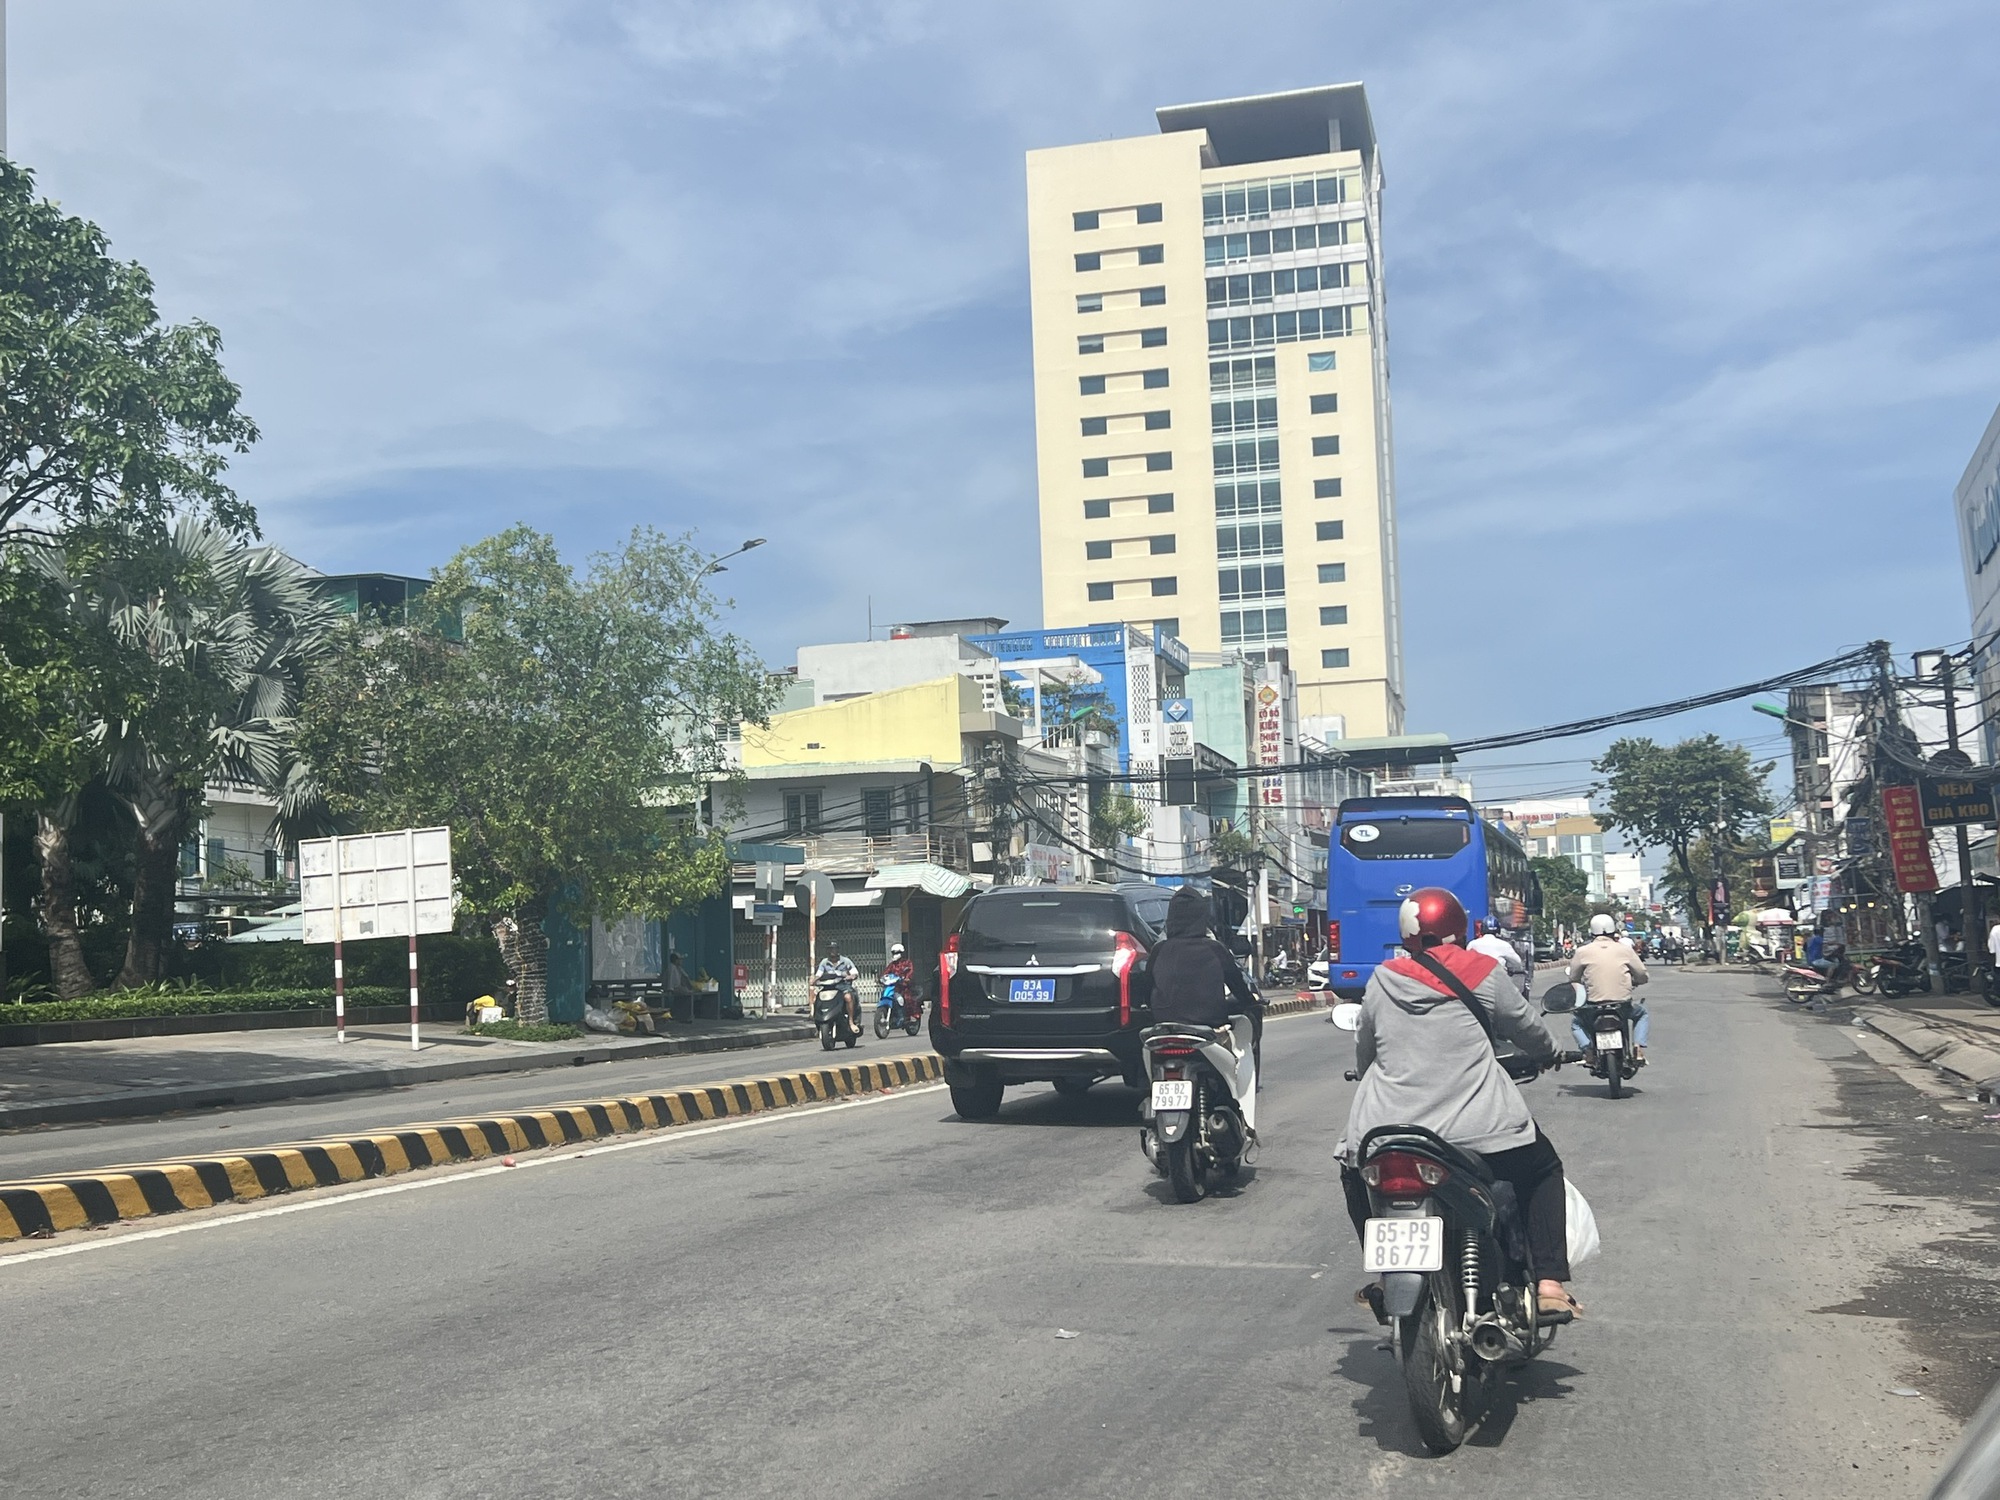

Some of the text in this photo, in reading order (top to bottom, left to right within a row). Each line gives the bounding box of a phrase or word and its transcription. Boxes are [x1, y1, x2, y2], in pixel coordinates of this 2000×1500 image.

[1166, 747, 1192, 757] TOURS
[1262, 788, 1283, 805] 15
[1938, 783, 1974, 799] NỆM
[1929, 803, 1954, 820] GIÁ
[1959, 804, 1988, 817] KHO
[1023, 980, 1042, 990] 83A
[1014, 991, 1049, 1001] 005.99
[1159, 1083, 1185, 1095] 65-B2
[1155, 1095, 1189, 1107] 799.77
[1376, 1221, 1430, 1243] 65-P9
[1375, 1244, 1430, 1266] 8677
